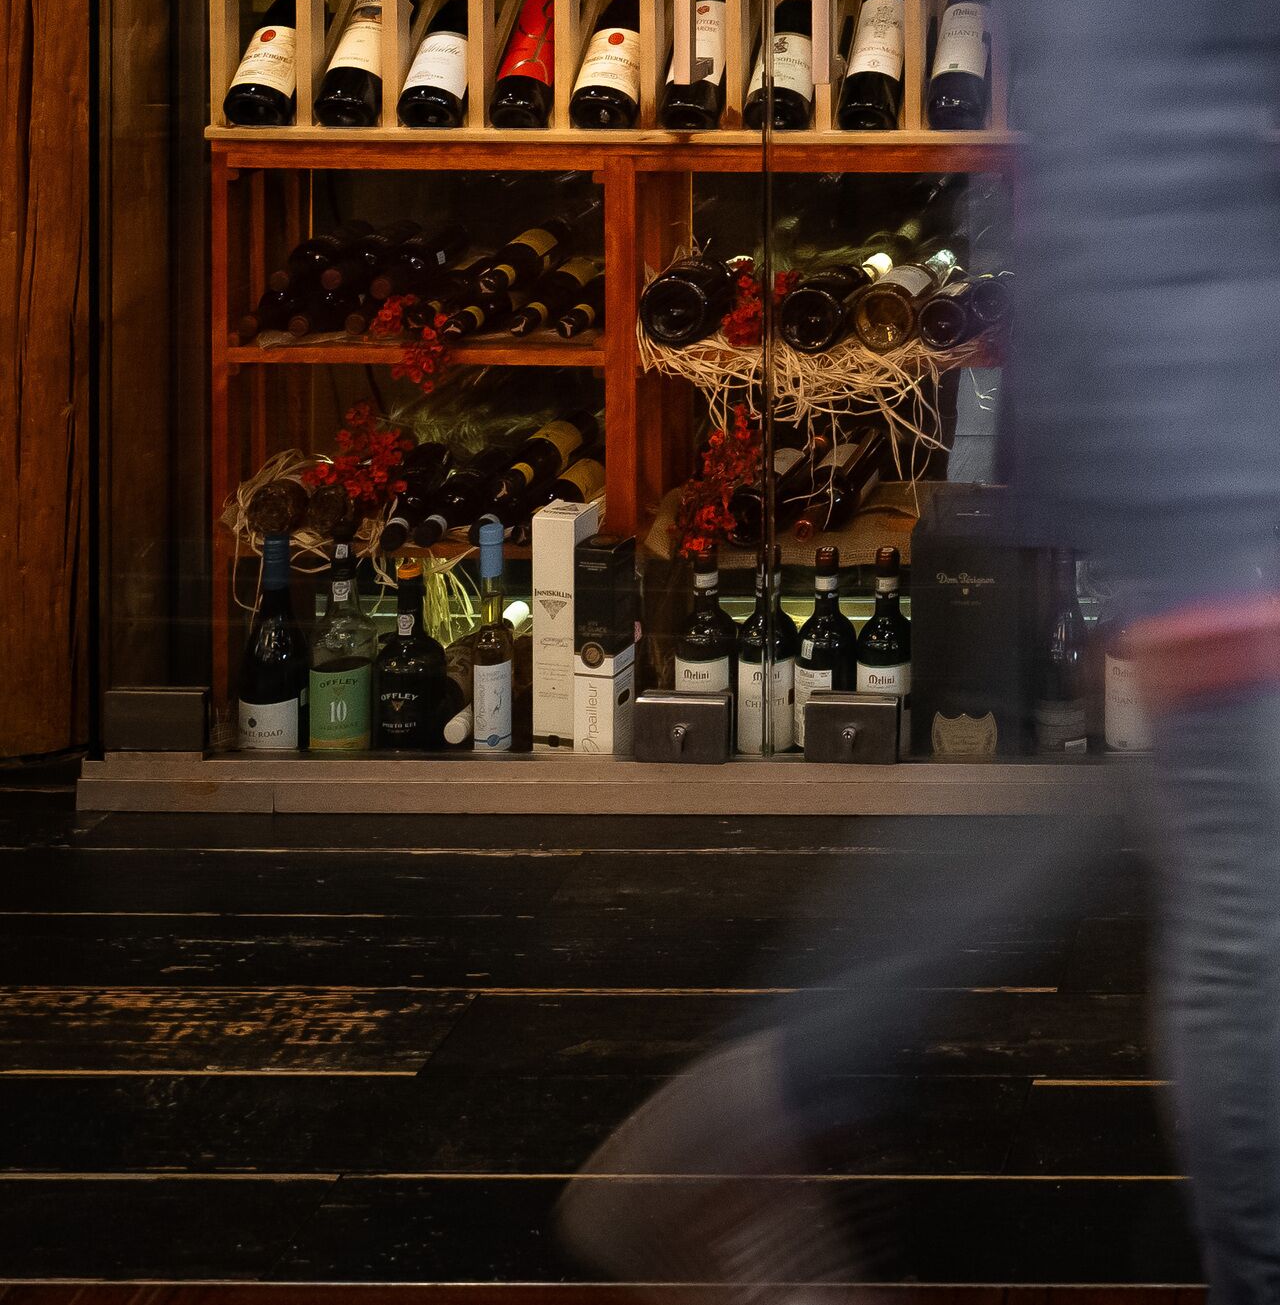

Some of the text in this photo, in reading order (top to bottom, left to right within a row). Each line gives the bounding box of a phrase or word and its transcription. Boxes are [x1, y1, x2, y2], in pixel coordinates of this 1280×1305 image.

[534, 588, 572, 600] INNISKILLIN
[683, 668, 710, 680] Melini
[868, 674, 895, 685] Melini
[320, 678, 358, 689] OFFLEY
[380, 692, 418, 701] OFFLEY
[329, 699, 348, 723] 10
